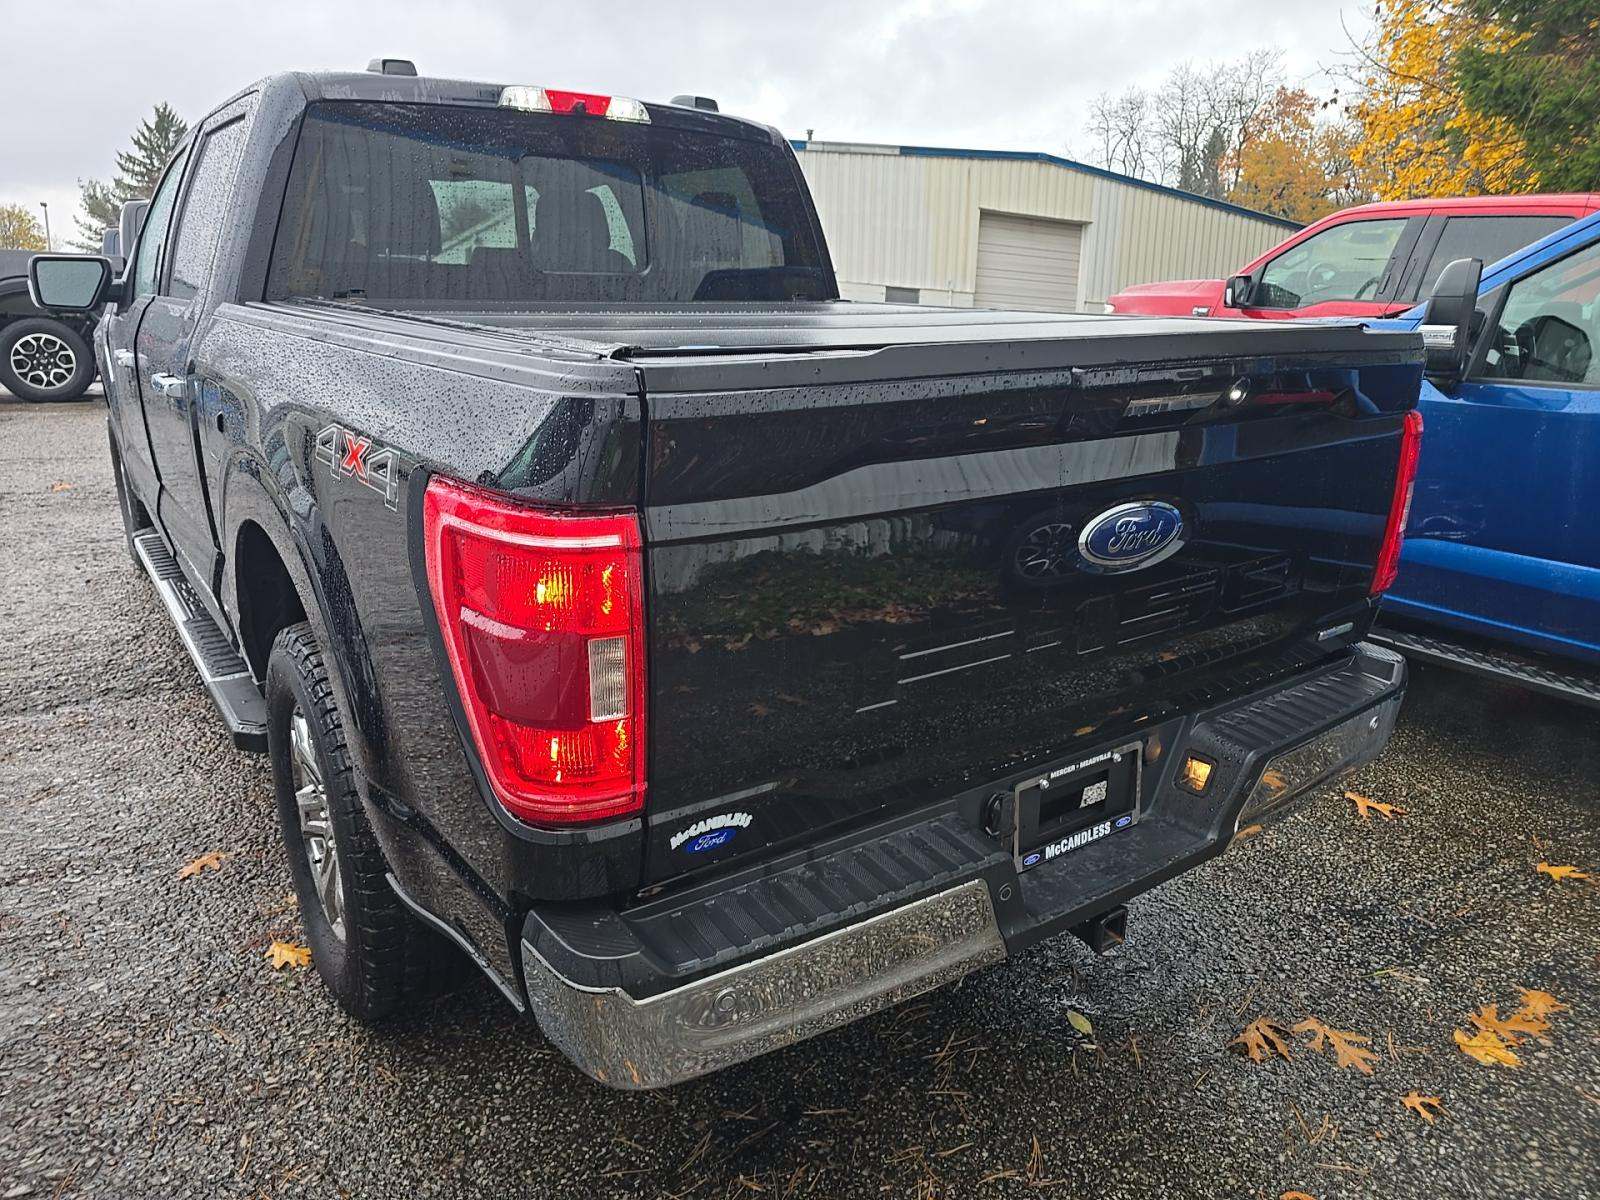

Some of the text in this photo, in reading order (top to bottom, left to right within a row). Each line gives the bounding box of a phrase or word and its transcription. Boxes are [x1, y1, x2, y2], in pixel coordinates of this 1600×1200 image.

[1108, 515, 1163, 553] Ford
[1050, 764, 1076, 779] MERCER
[670, 812, 753, 850] McCANDLESS
[694, 831, 727, 851] Ford
[1045, 821, 1111, 860] McCANDLESS
